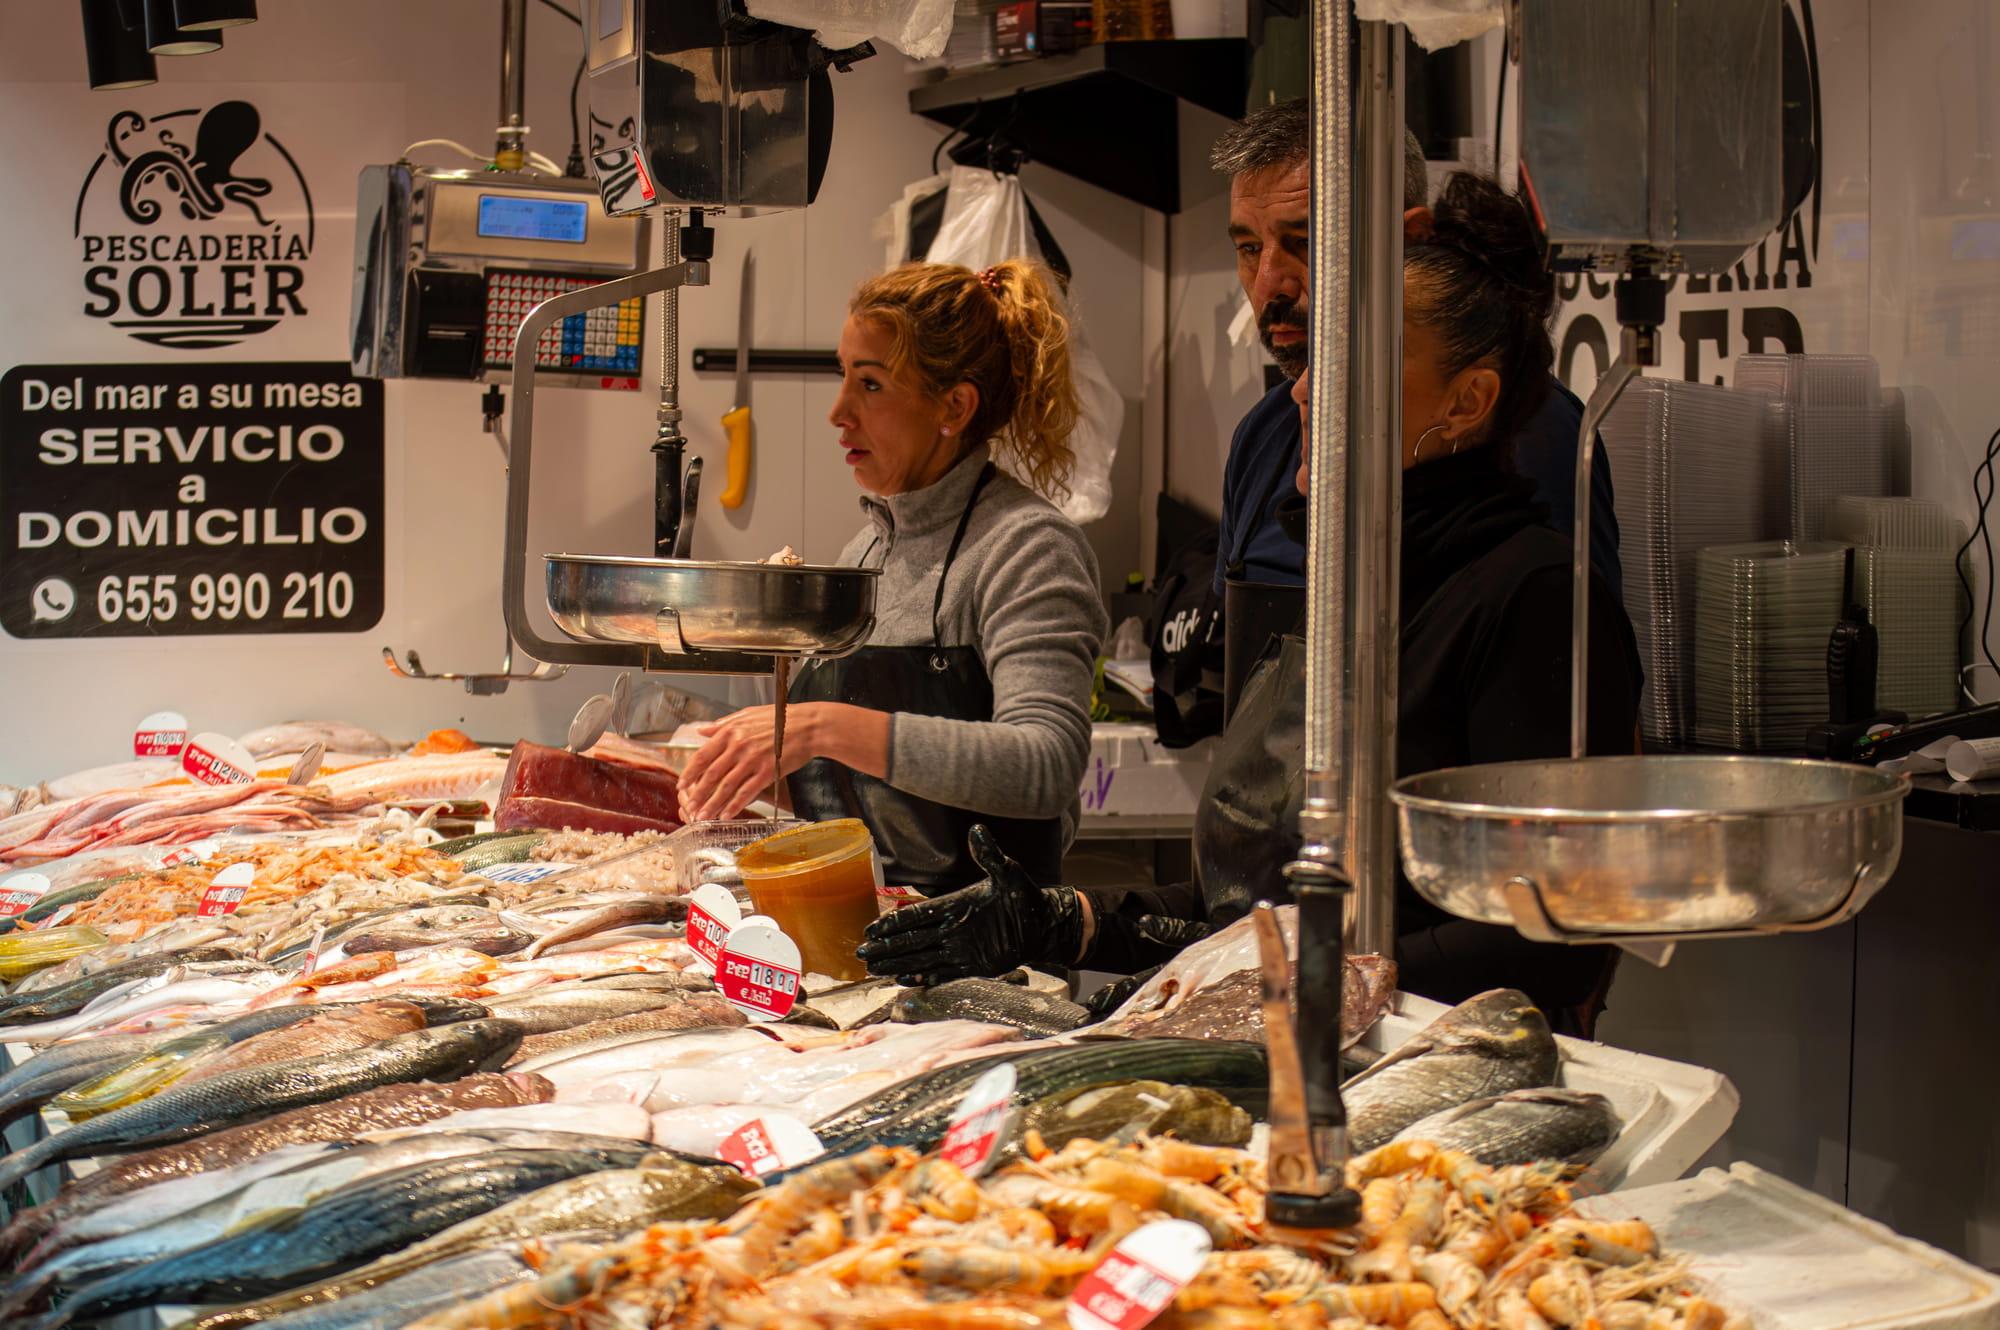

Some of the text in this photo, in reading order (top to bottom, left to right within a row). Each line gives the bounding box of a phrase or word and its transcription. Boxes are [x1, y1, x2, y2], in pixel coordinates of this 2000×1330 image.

[83, 225, 309, 262] PESCADERÍA
[84, 264, 308, 318] SOLER
[22, 377, 363, 411] Del mar a su mesa
[38, 424, 345, 465] SERVICIO
[178, 473, 206, 503] a
[18, 507, 367, 548] DOMICILIO
[98, 571, 354, 622] 655 990 210
